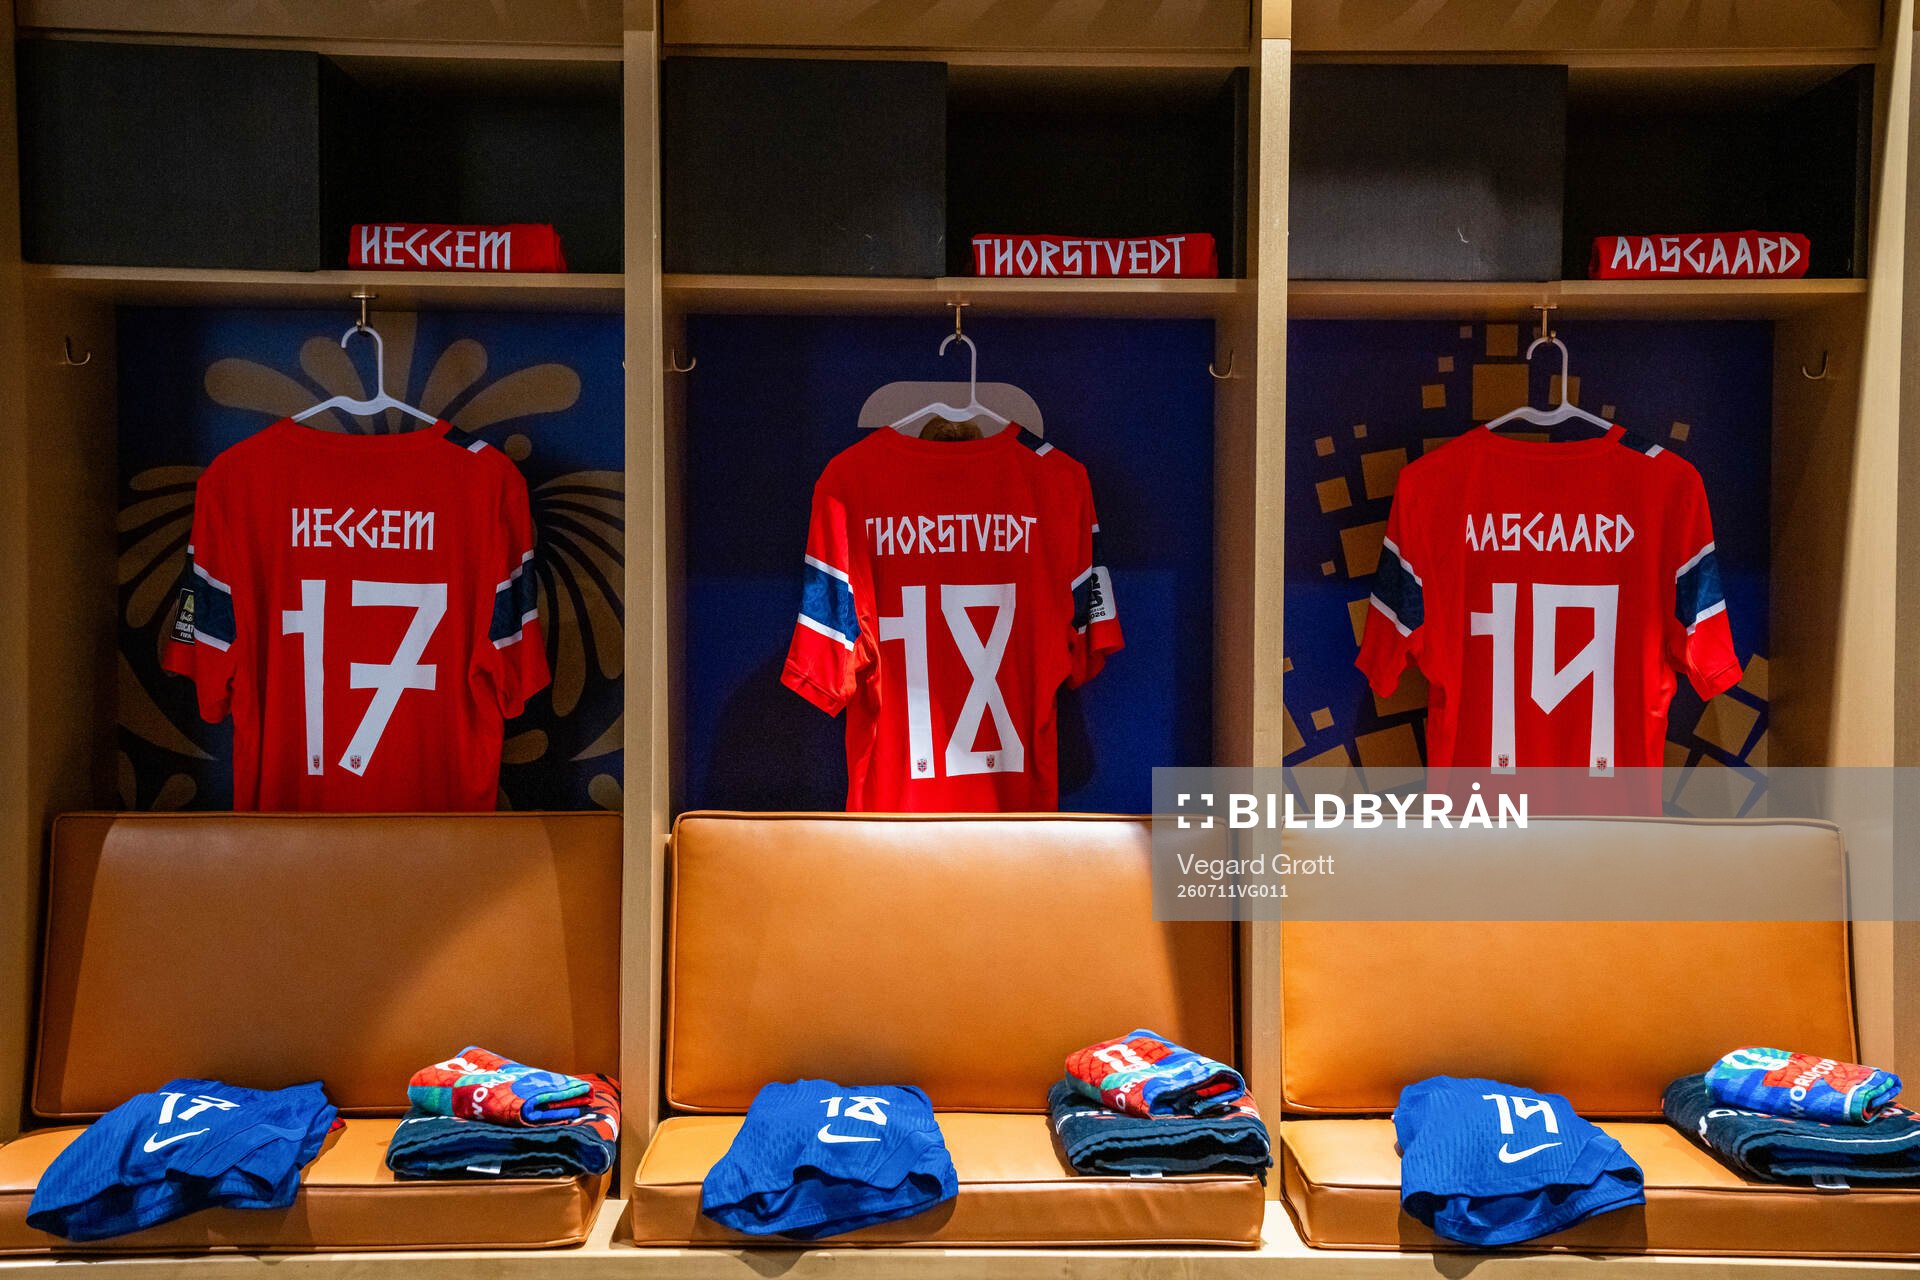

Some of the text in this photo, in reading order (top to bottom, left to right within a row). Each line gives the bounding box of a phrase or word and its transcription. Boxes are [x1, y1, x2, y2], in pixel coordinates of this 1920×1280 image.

[360, 226, 511, 270] HEGGEM
[972, 236, 1186, 276] THORSTVEDT
[1610, 236, 1801, 274] AASGAARD
[291, 507, 435, 550] HEGGEM
[1465, 512, 1635, 553] AASGAARD
[282, 579, 448, 777] 17
[878, 582, 1025, 780] 18
[1470, 582, 1620, 778] 19
[158, 1092, 241, 1125] 17
[820, 1096, 891, 1126] 18
[1482, 1093, 1559, 1135] 19
